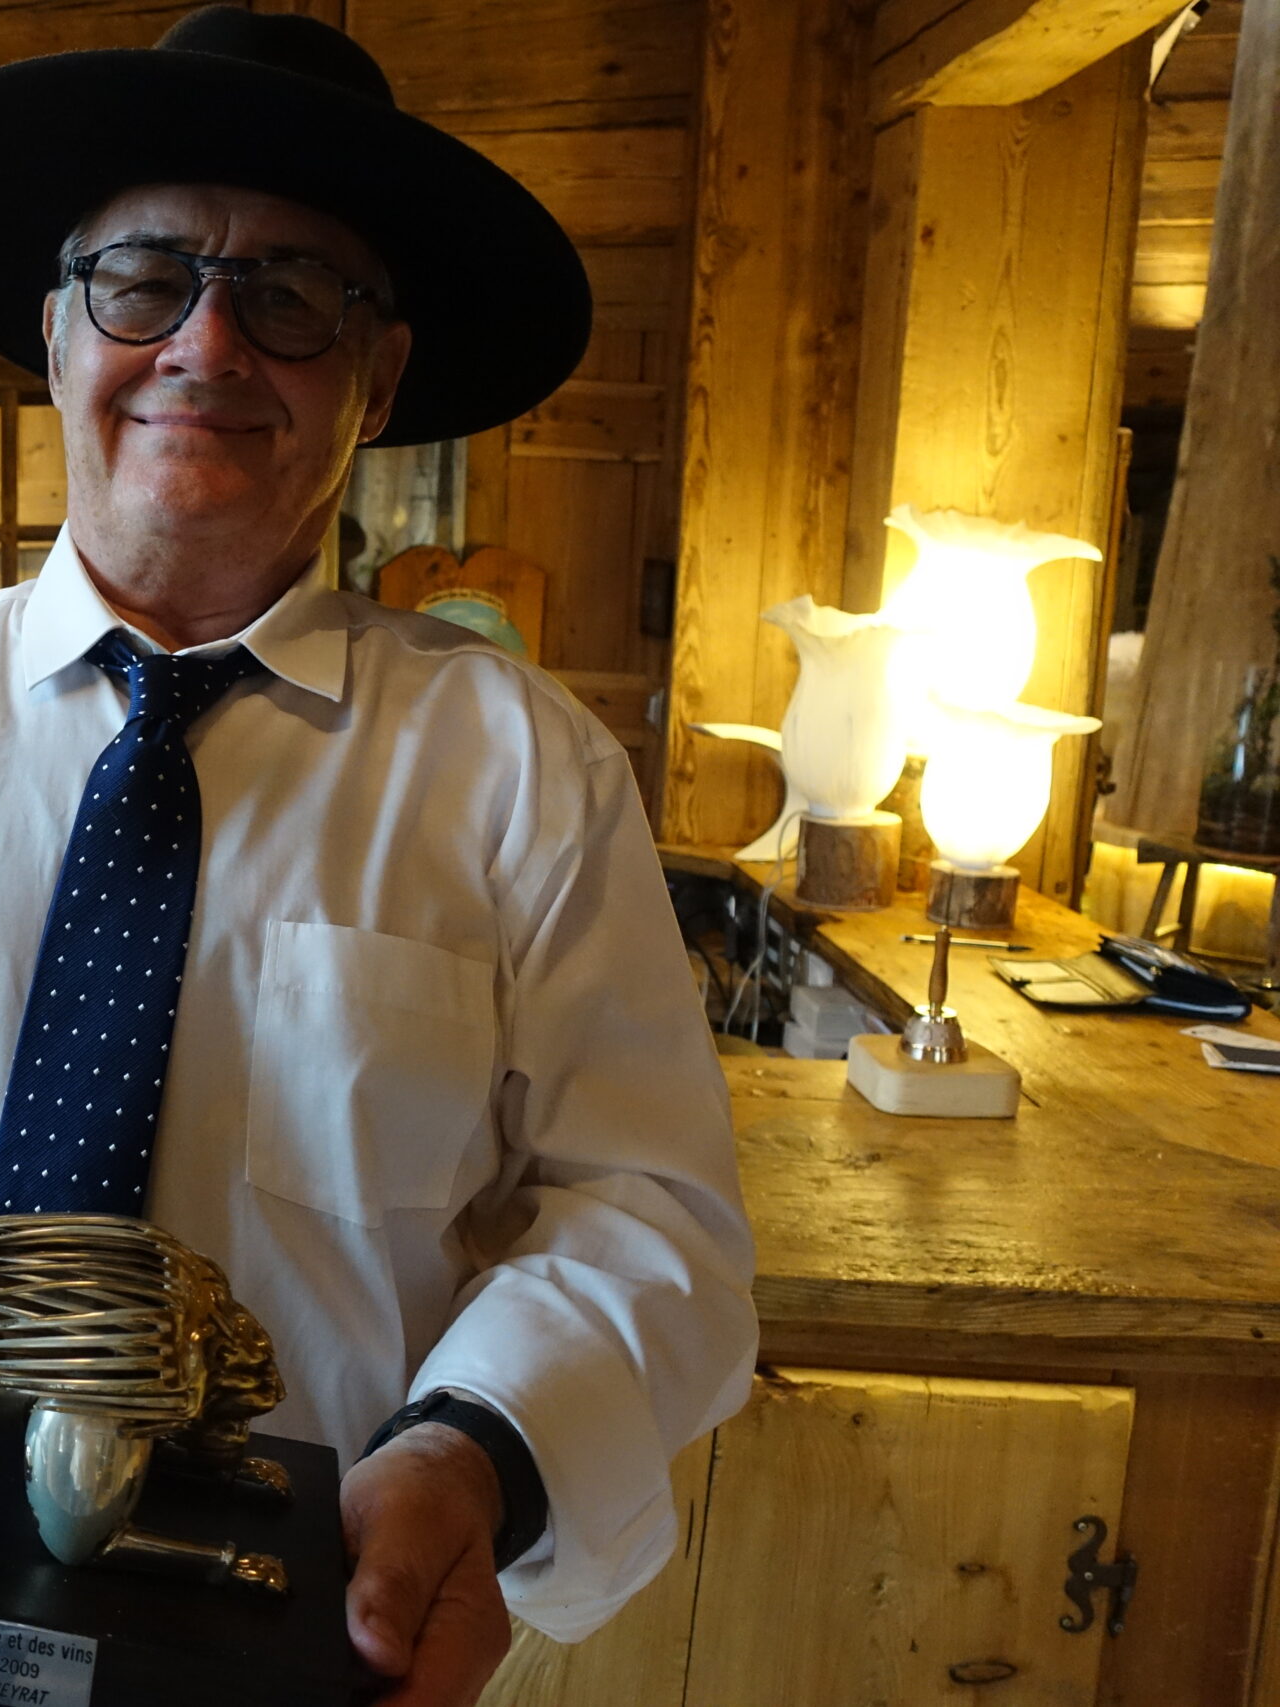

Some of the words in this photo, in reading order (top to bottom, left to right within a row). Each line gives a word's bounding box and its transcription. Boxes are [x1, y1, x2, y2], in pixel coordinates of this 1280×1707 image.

[8, 1633, 22, 1650] et
[28, 1636, 55, 1657] des
[62, 1643, 93, 1665] vins
[0, 1657, 40, 1678] 2009
